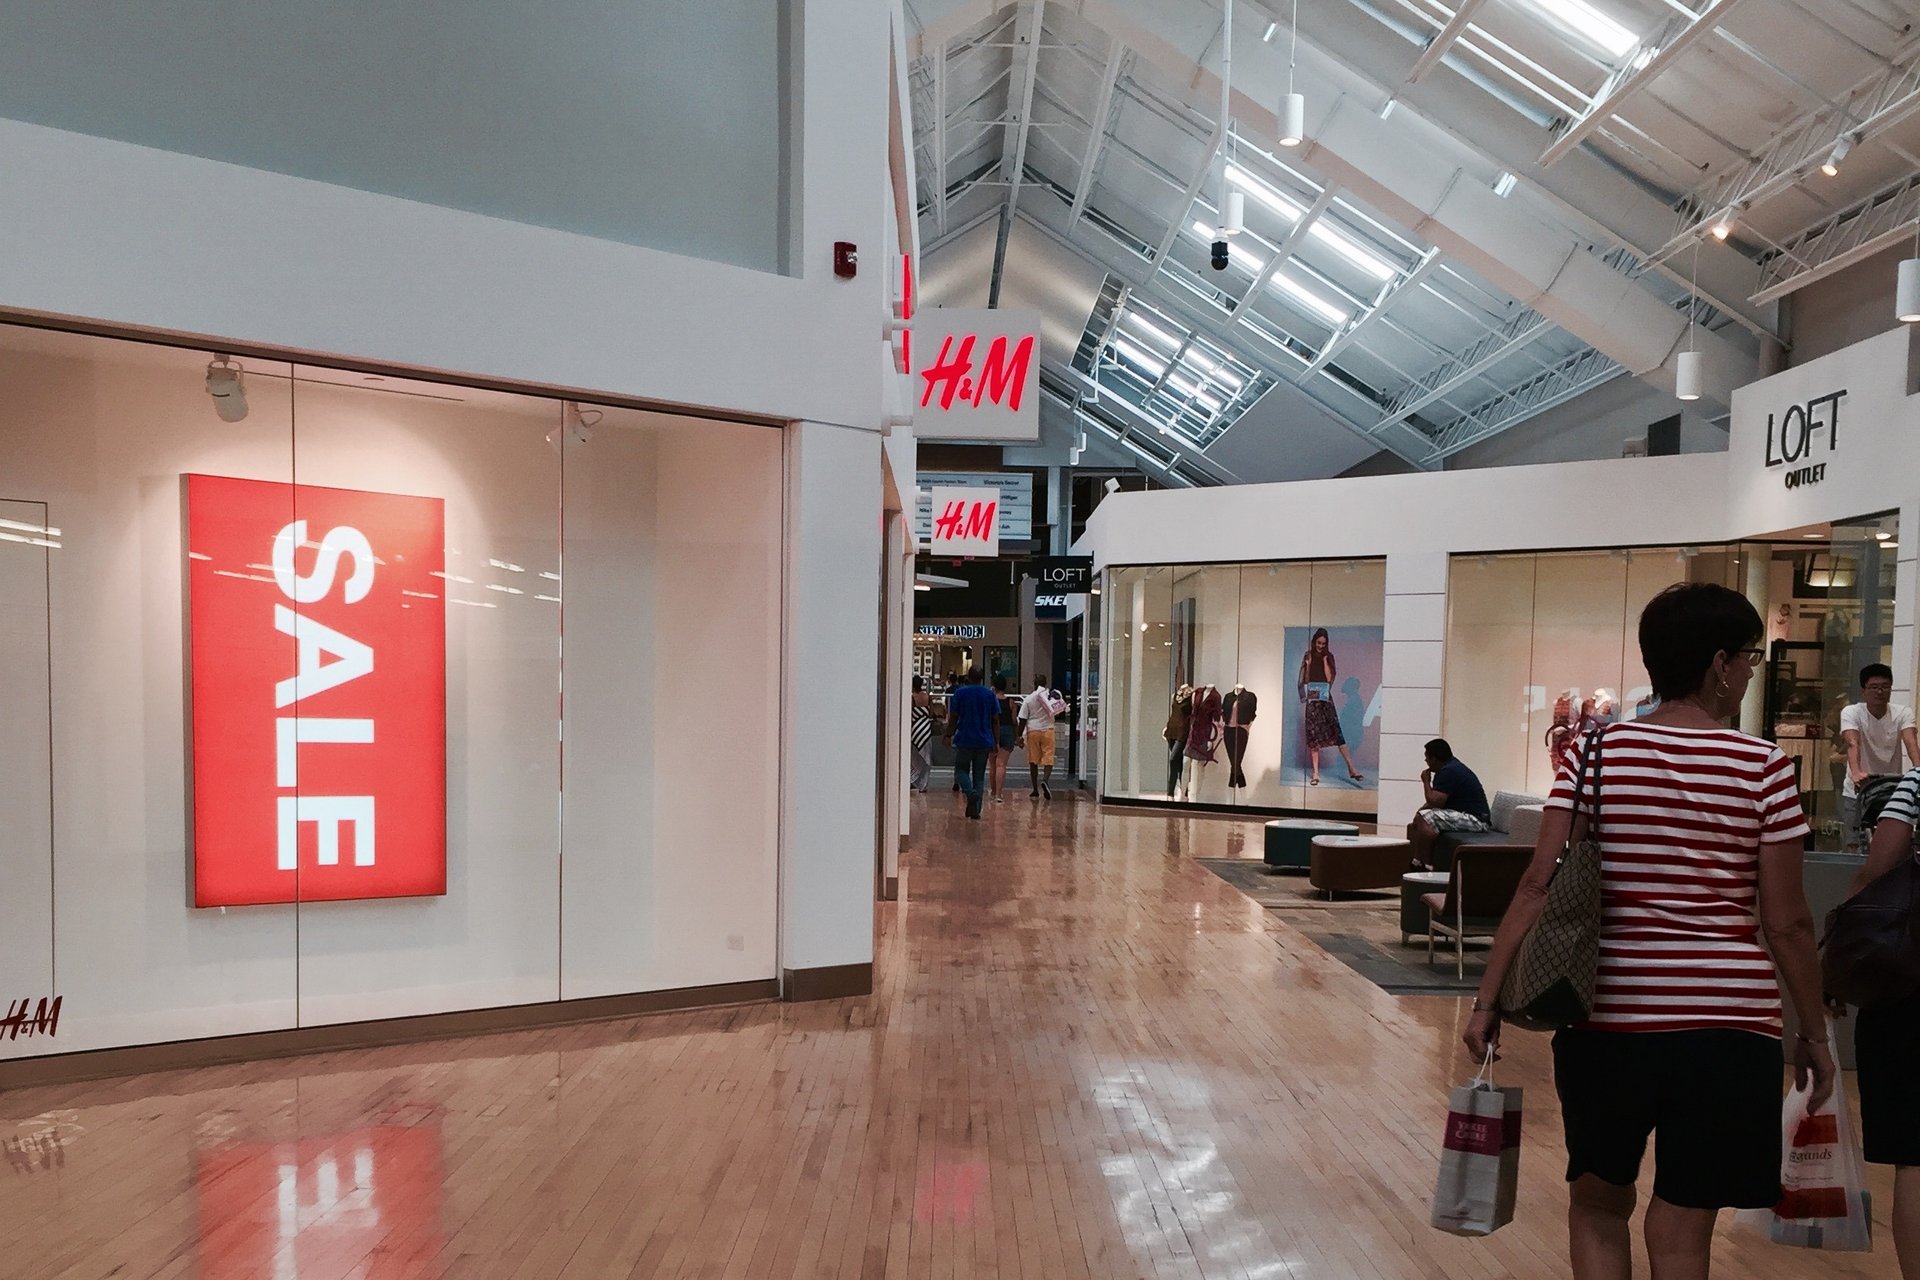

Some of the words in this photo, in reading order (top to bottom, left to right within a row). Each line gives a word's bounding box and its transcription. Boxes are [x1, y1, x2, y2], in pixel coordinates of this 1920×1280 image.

[921, 335, 1034, 412] H&M
[1765, 389, 1847, 467] LOFT
[1785, 463, 1827, 489] OUTLET
[935, 501, 996, 542] H&M
[1044, 568, 1086, 581] LOFT
[948, 625, 986, 639] MADDEN
[272, 519, 375, 870] SALE
[0, 995, 63, 1041] H&M
